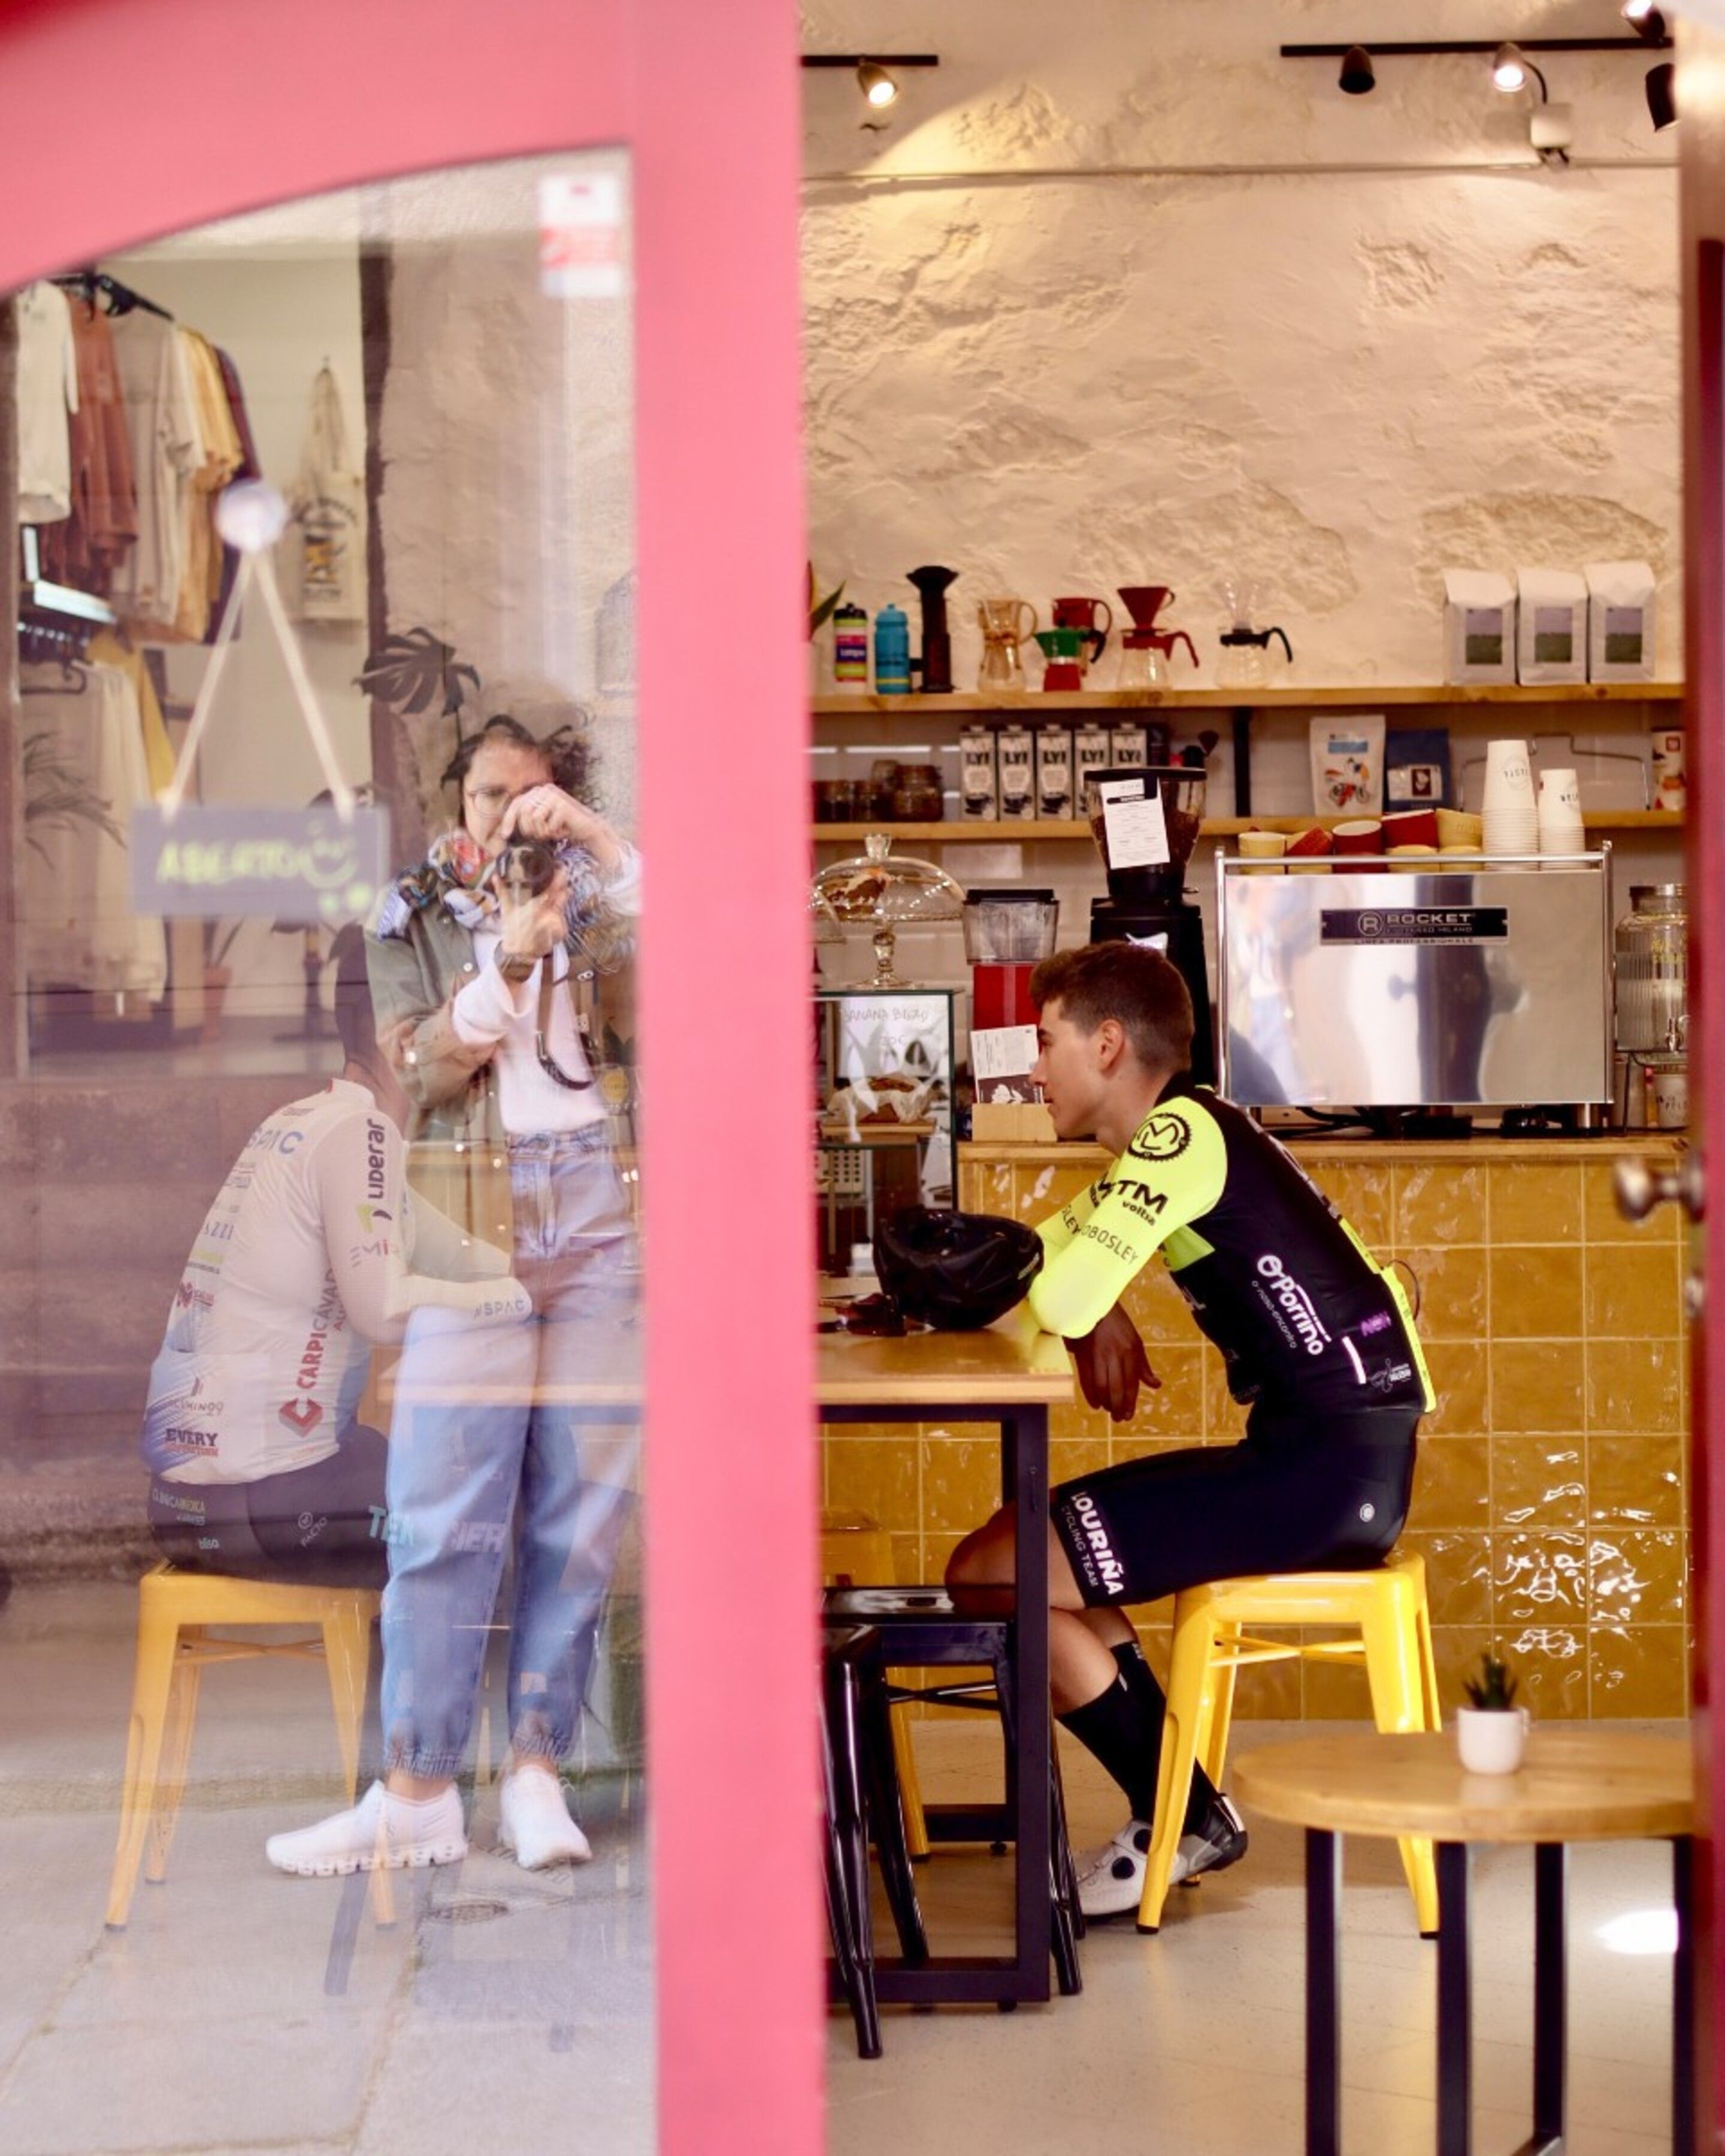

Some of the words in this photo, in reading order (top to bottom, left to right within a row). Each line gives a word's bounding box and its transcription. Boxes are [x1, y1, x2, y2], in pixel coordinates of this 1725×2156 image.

[1387, 913, 1470, 924] ROCKET
[165, 1428, 218, 1447] EVERY
[1061, 1505, 1087, 1552] CYCLING
[1081, 1553, 1098, 1588] TEAM
